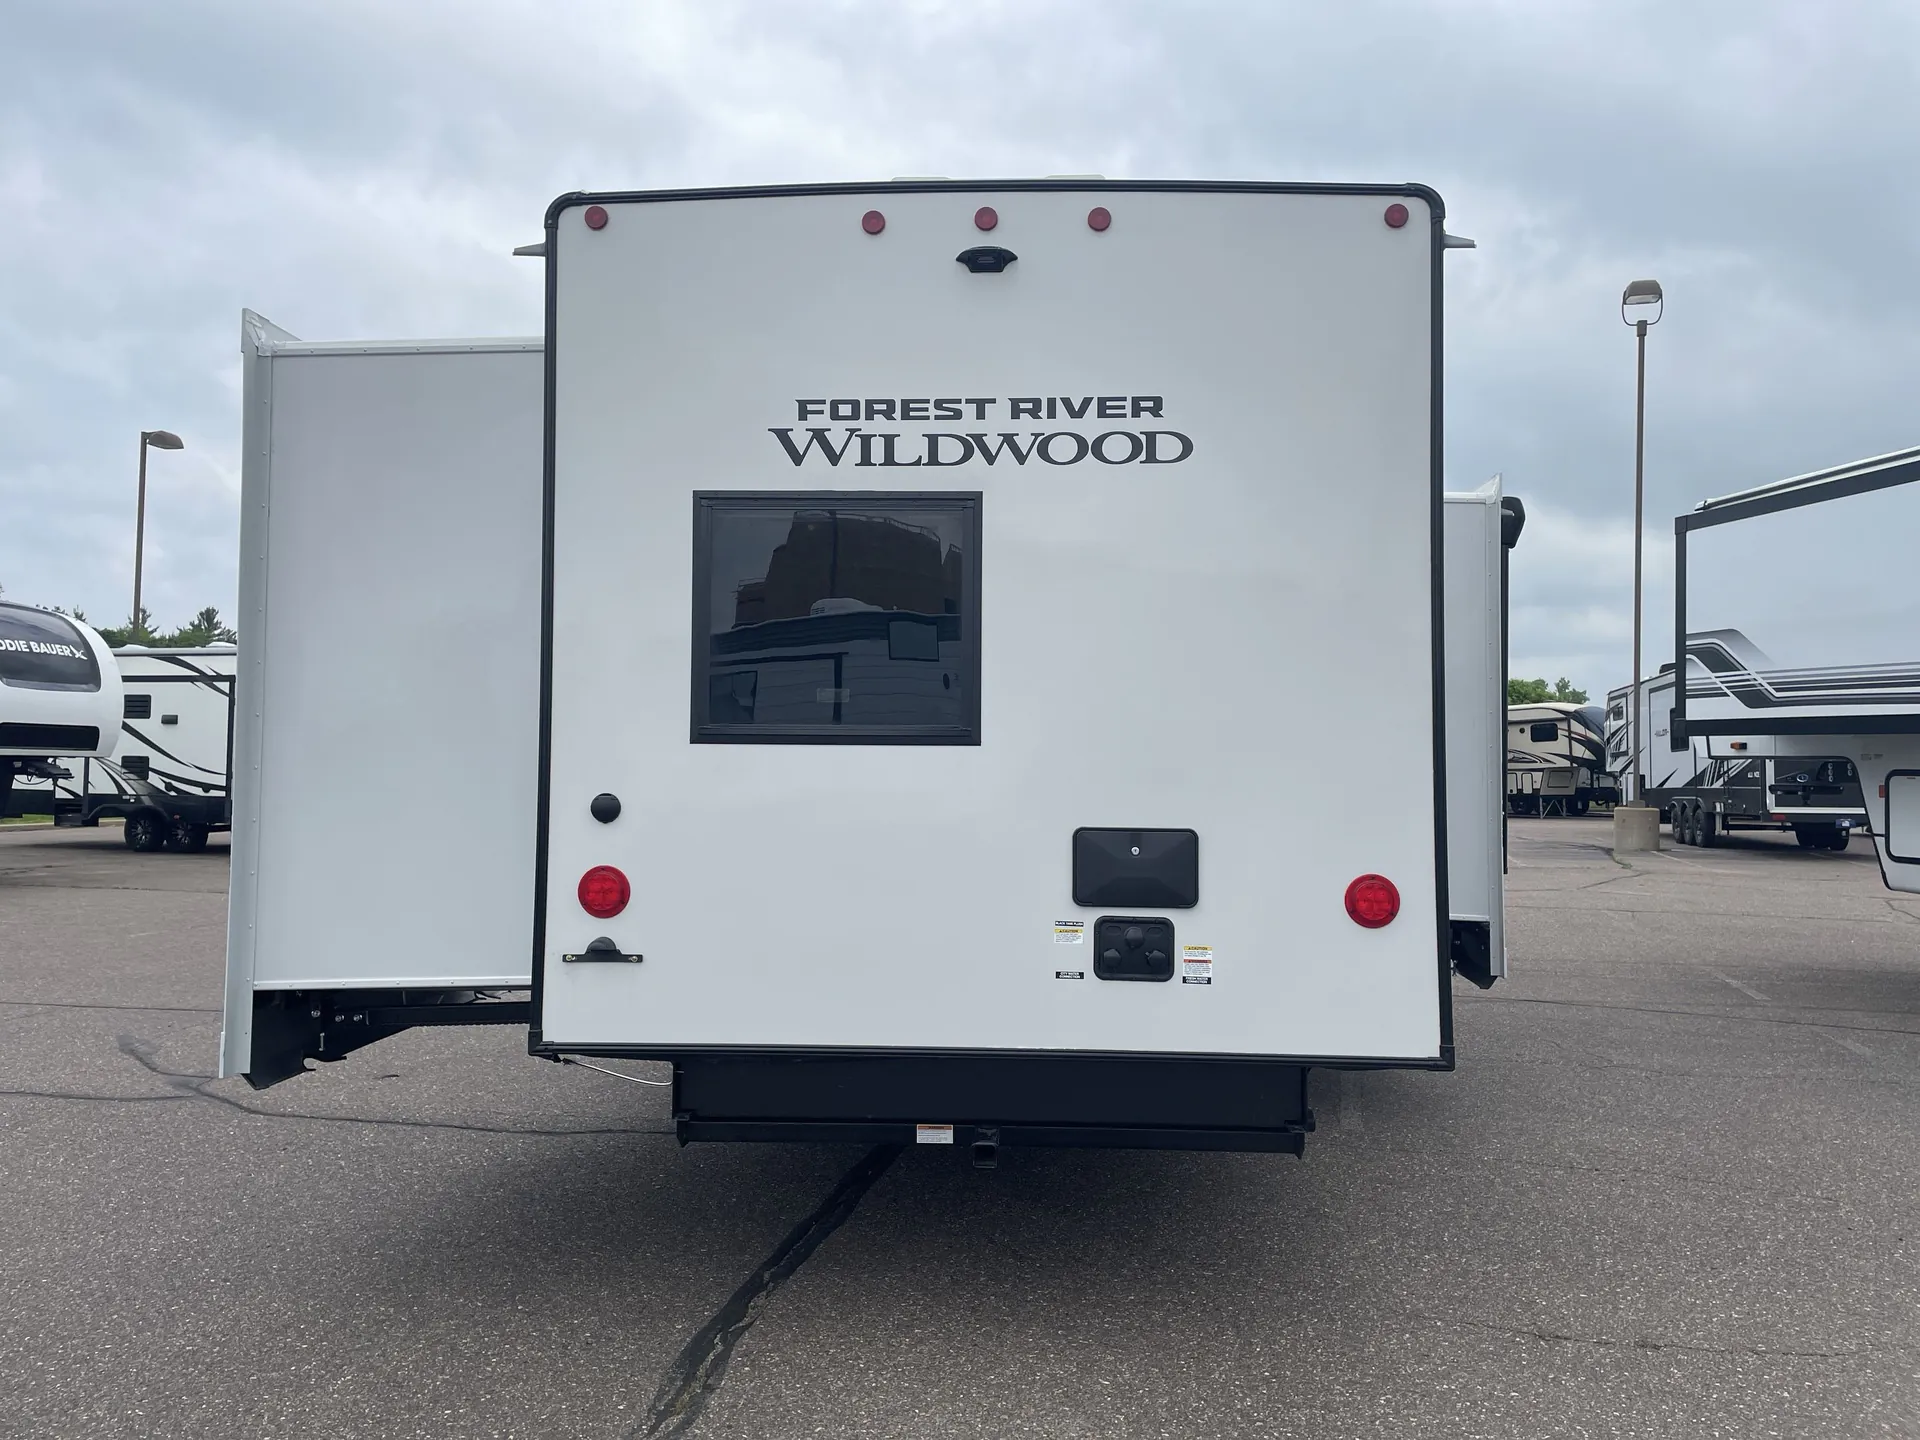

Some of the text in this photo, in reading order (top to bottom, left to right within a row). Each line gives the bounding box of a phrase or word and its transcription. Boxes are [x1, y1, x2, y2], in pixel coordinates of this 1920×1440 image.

[795, 396, 1165, 421] FOREST RIVER
[767, 427, 1194, 467] WILDWOOD
[30, 641, 72, 656] BAUER
